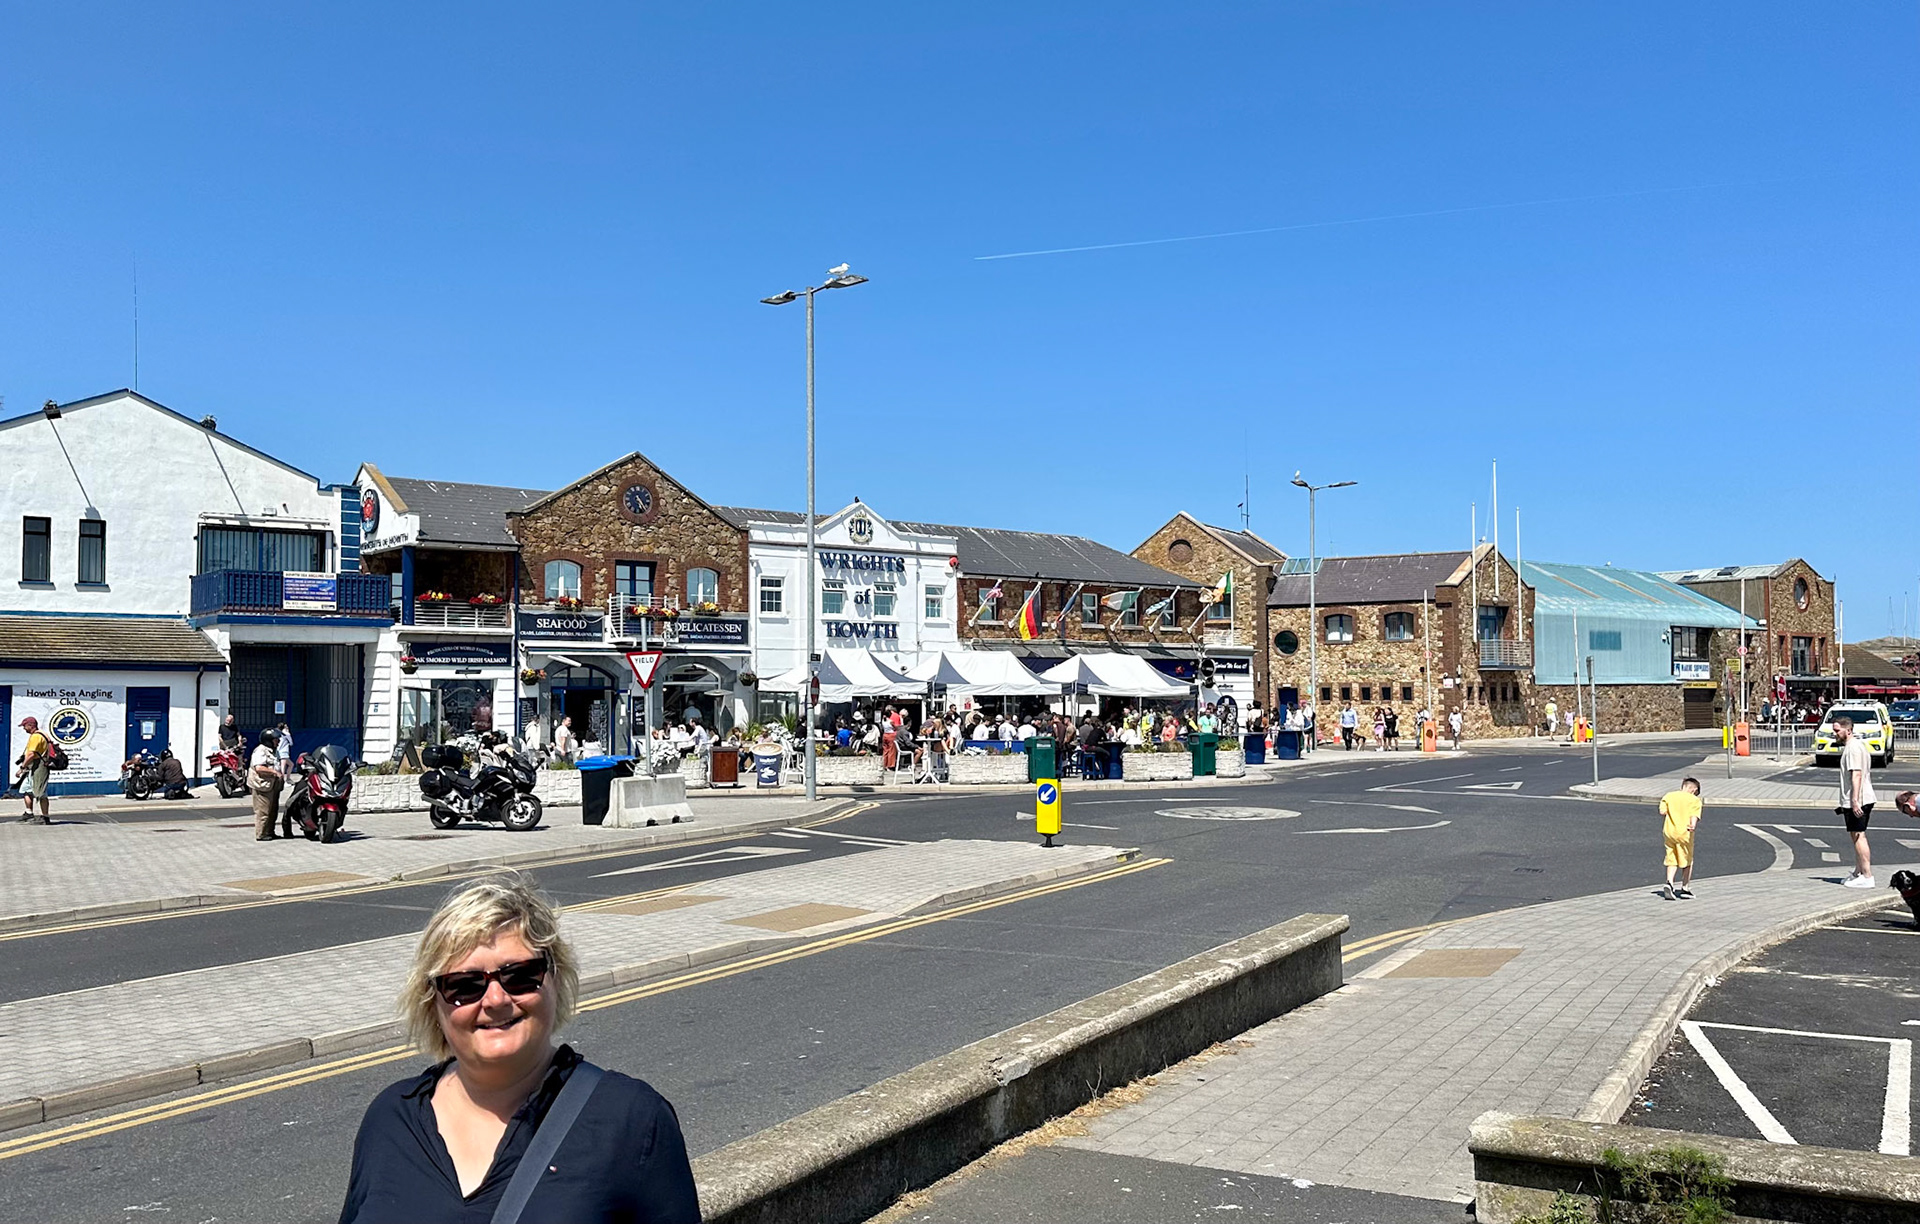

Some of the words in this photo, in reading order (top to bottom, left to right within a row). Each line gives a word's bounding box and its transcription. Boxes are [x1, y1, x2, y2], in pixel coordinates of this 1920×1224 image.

[819, 552, 905, 572] WRIGHTS
[536, 618, 587, 629] SEAFOOD
[675, 622, 742, 633] DELICATESSEN
[826, 621, 898, 639] HOWTH
[634, 656, 654, 664] YIELD
[26, 688, 57, 697] Howth
[59, 689, 76, 697] Sea
[78, 689, 113, 699] Angling
[59, 698, 81, 706] Club
